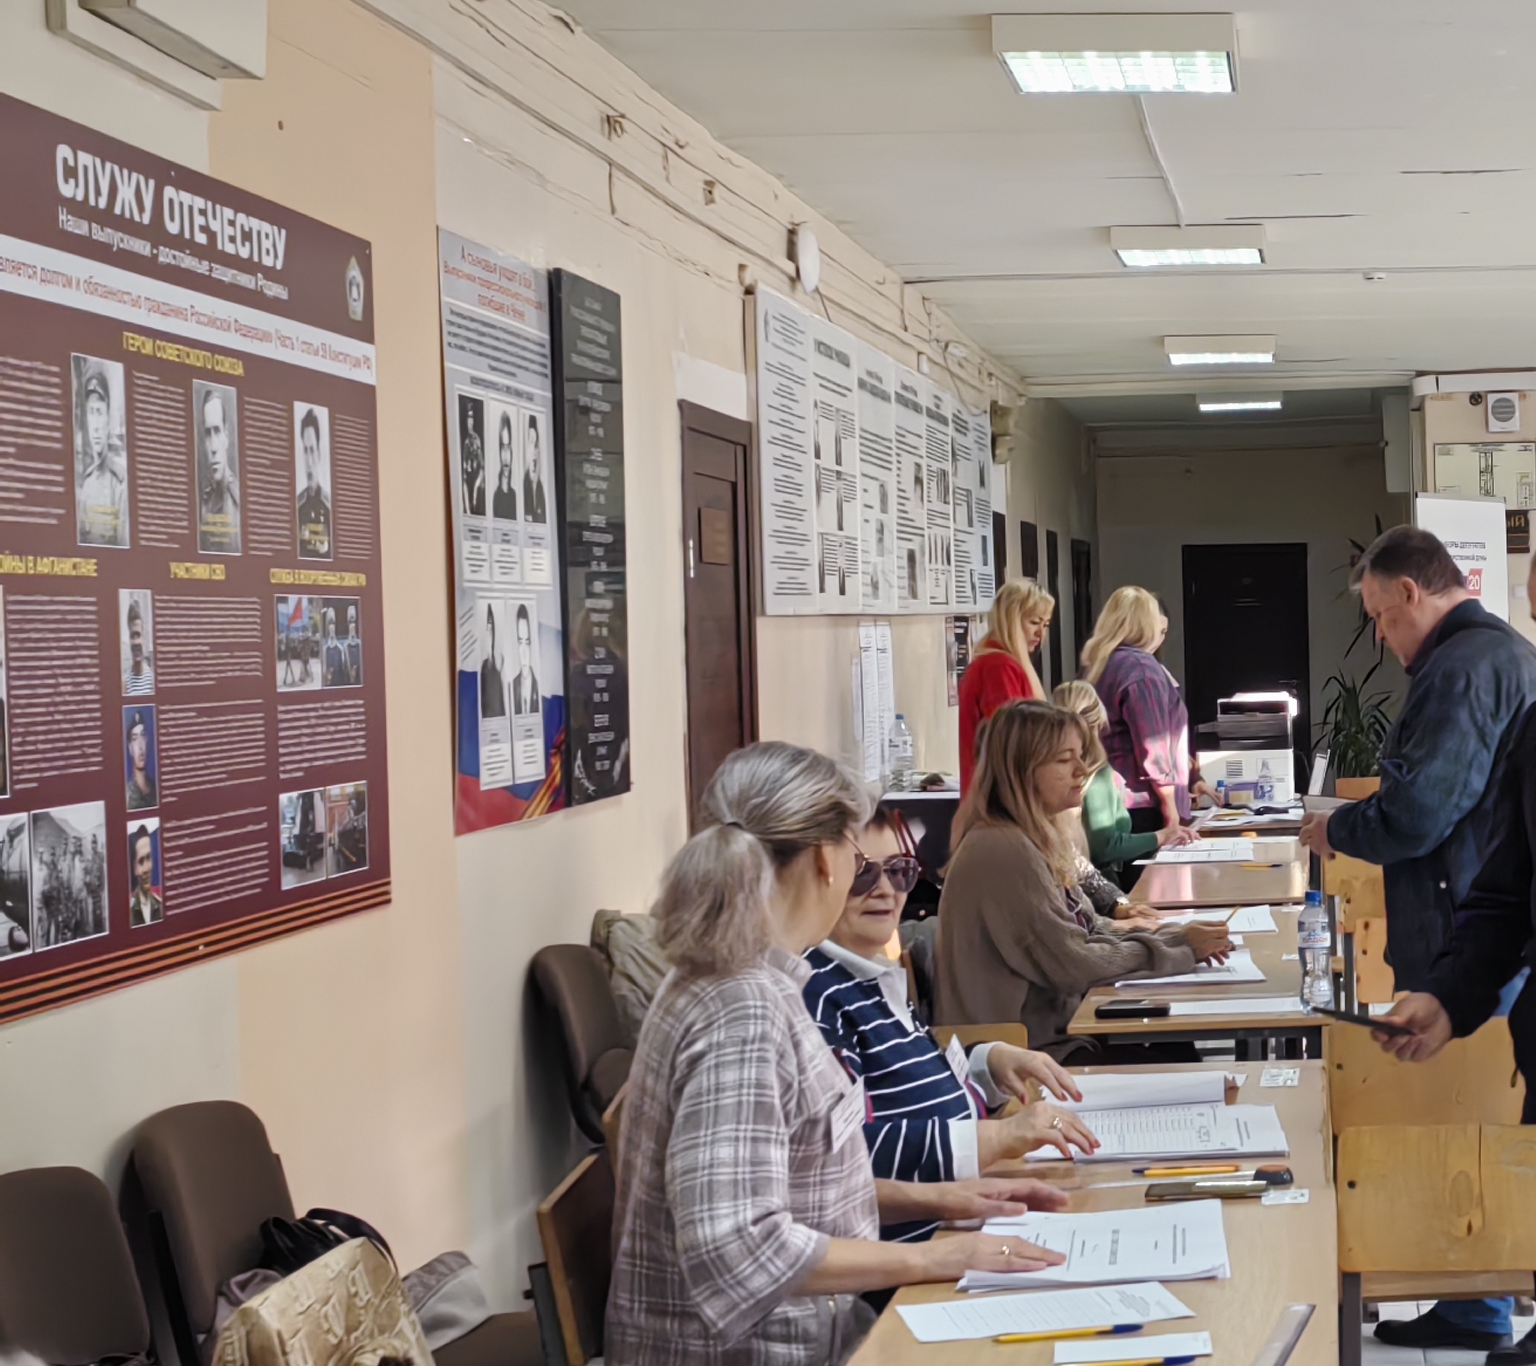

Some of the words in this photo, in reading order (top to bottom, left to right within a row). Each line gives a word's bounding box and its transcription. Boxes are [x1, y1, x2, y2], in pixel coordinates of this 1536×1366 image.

[56, 143, 155, 225] СЛУЖУ
[163, 185, 287, 270] ОТЕЧЕСТВУ
[59, 206, 89, 236] Наши
[91, 222, 151, 258] выпускники
[158, 245, 209, 275] достойные
[123, 331, 153, 355] ГЕРОИ
[154, 339, 213, 370] СОВЕТСКОГО
[27, 556, 34, 574] В
[36, 556, 98, 577] АФГАНИСТАНЕ
